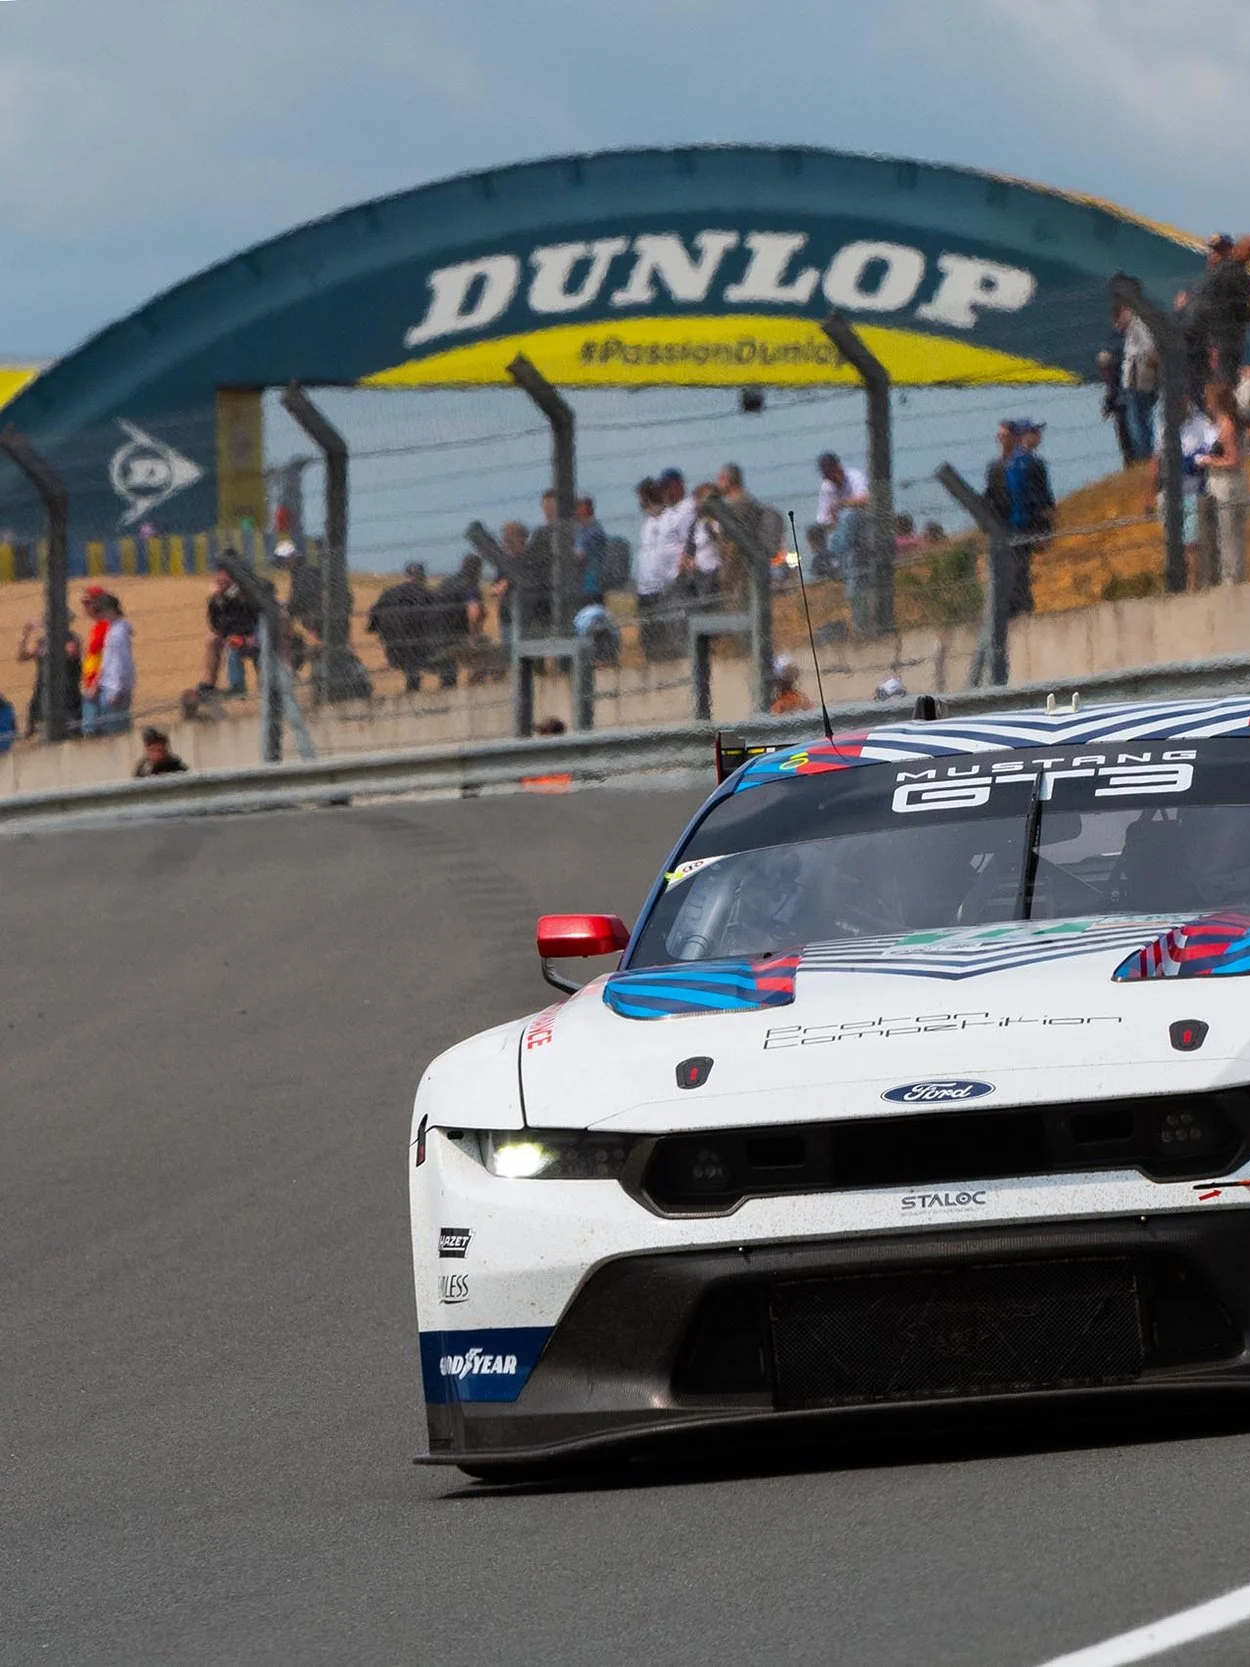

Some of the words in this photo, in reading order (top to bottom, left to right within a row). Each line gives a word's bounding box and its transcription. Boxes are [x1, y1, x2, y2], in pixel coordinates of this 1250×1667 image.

[404, 229, 1036, 348] DUNLOP
[896, 750, 1197, 782] MUSTANG
[891, 763, 1193, 813] GT3
[766, 1011, 989, 1039] Proton
[902, 1081, 974, 1101] Ford
[901, 1190, 986, 1210] STALOC
